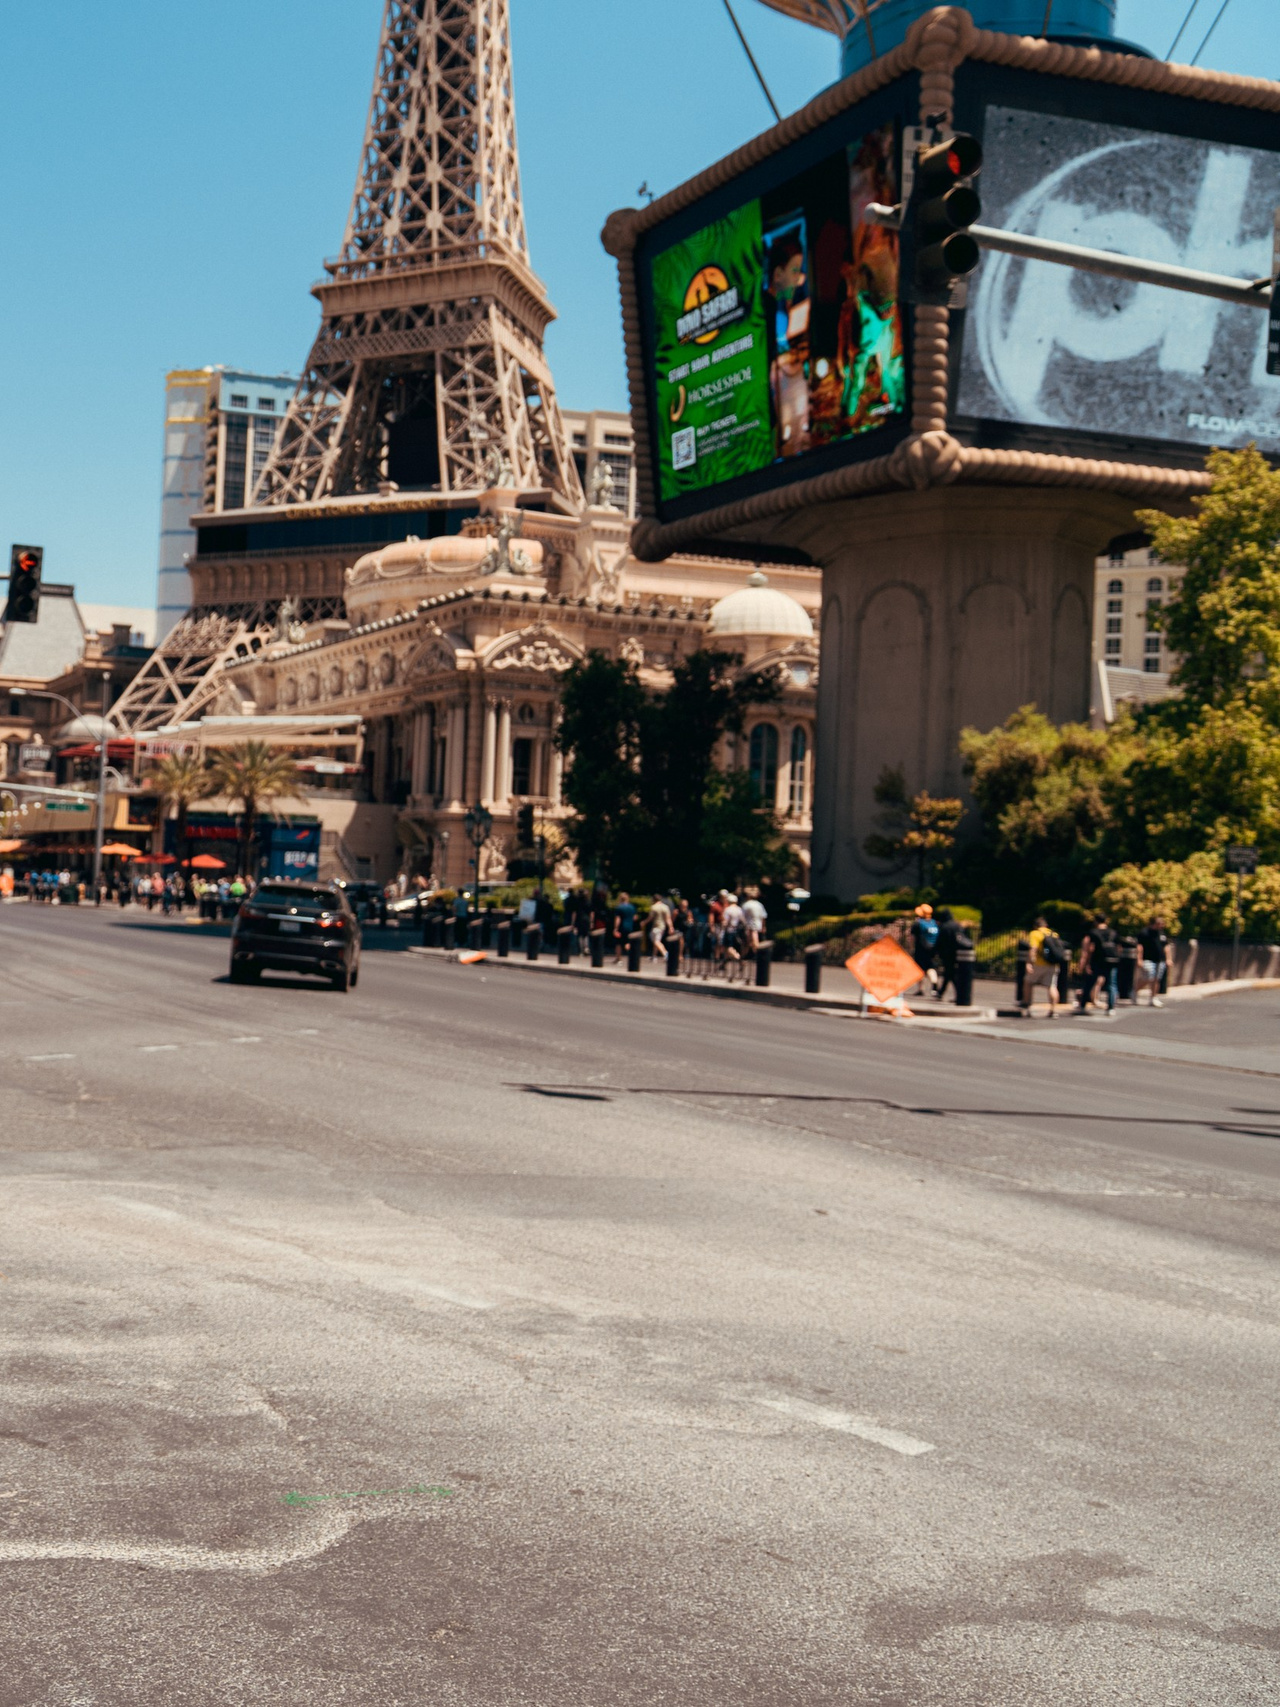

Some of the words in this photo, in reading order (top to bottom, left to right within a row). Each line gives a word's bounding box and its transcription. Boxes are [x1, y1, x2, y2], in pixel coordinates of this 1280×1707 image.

[701, 286, 738, 324] SAFARI
[668, 362, 690, 384] START
[711, 333, 754, 365] ADVENTURE
[688, 365, 752, 405] HORSESHOE
